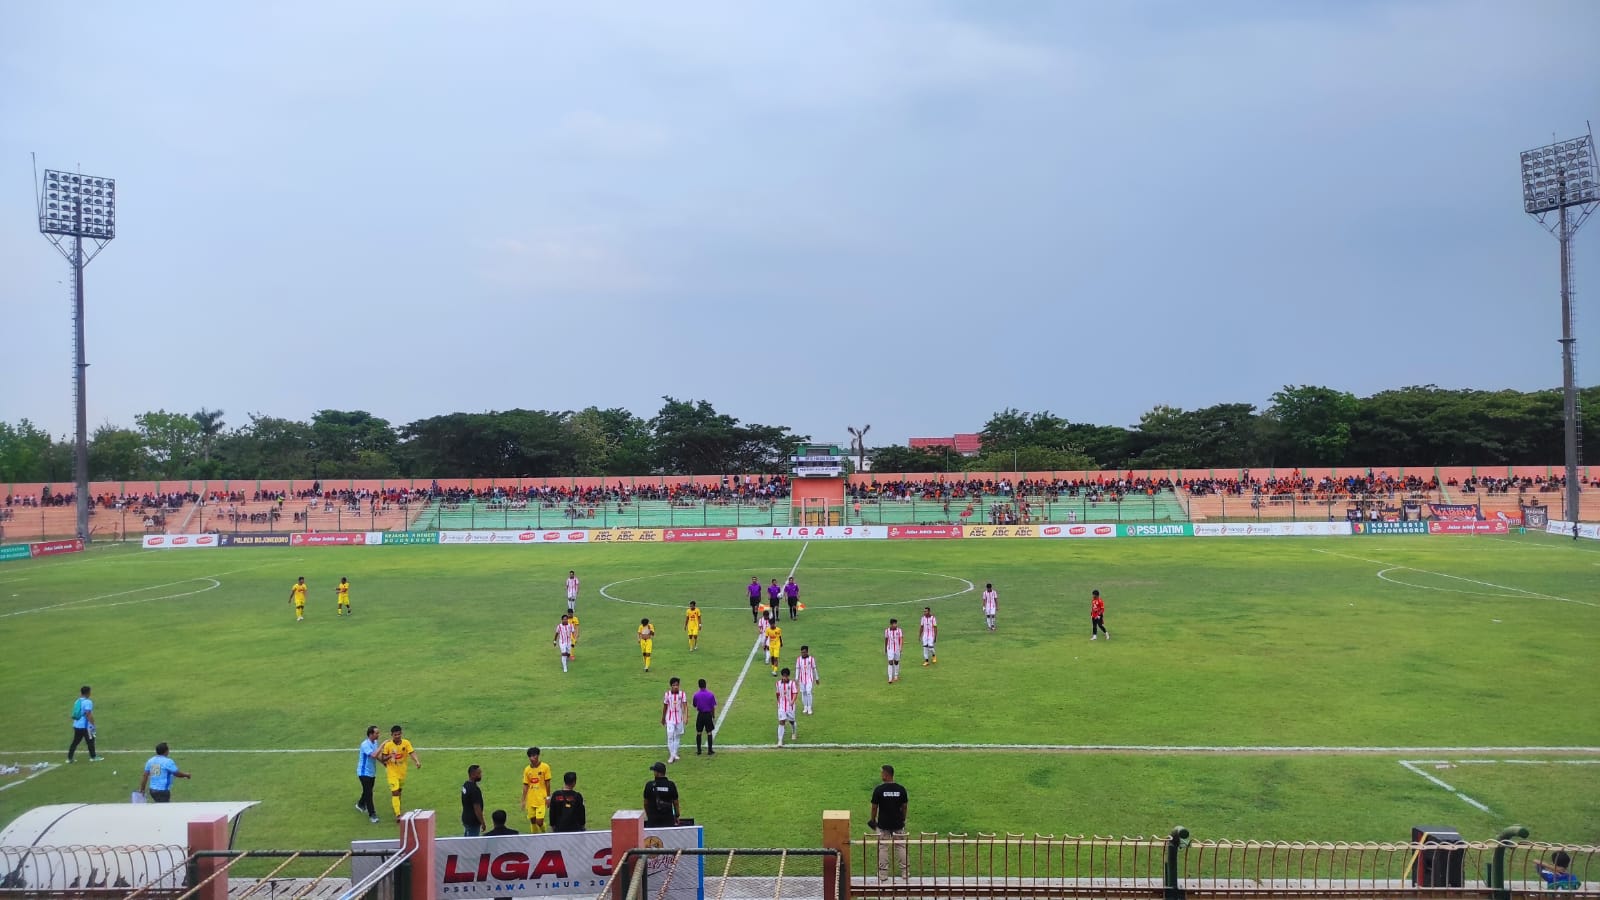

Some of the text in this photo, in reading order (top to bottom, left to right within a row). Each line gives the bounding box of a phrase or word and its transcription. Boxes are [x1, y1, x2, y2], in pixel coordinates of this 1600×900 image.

[772, 527, 853, 536] LIGA 3
[1136, 525, 1184, 534] PSSI JATIM
[443, 850, 569, 884] LIGA
[443, 886, 476, 894] PSSI
[486, 883, 526, 892] JAWA
[535, 881, 582, 890] TIMUR
